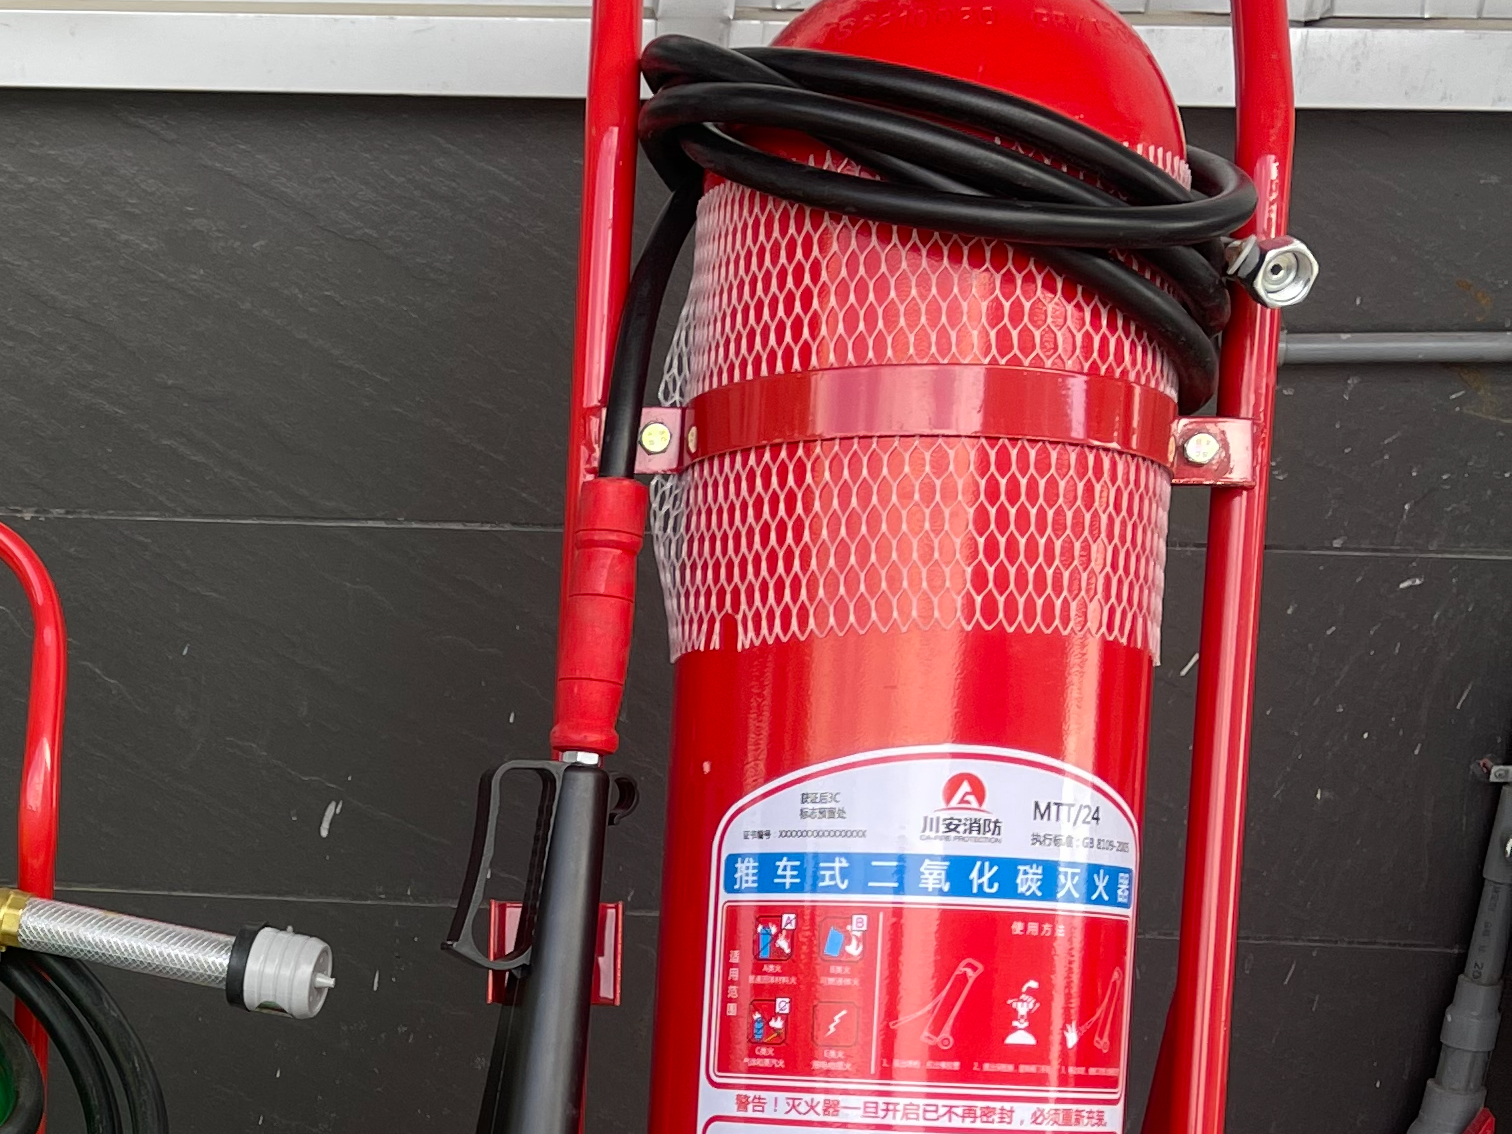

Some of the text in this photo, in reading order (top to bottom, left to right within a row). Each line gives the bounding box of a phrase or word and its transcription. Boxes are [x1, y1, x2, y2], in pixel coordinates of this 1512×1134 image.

[920, 816, 1003, 836] 川安消防
[1033, 801, 1100, 826] MTT/24
[733, 855, 1129, 904] 推车式二氧化碳灭火器
